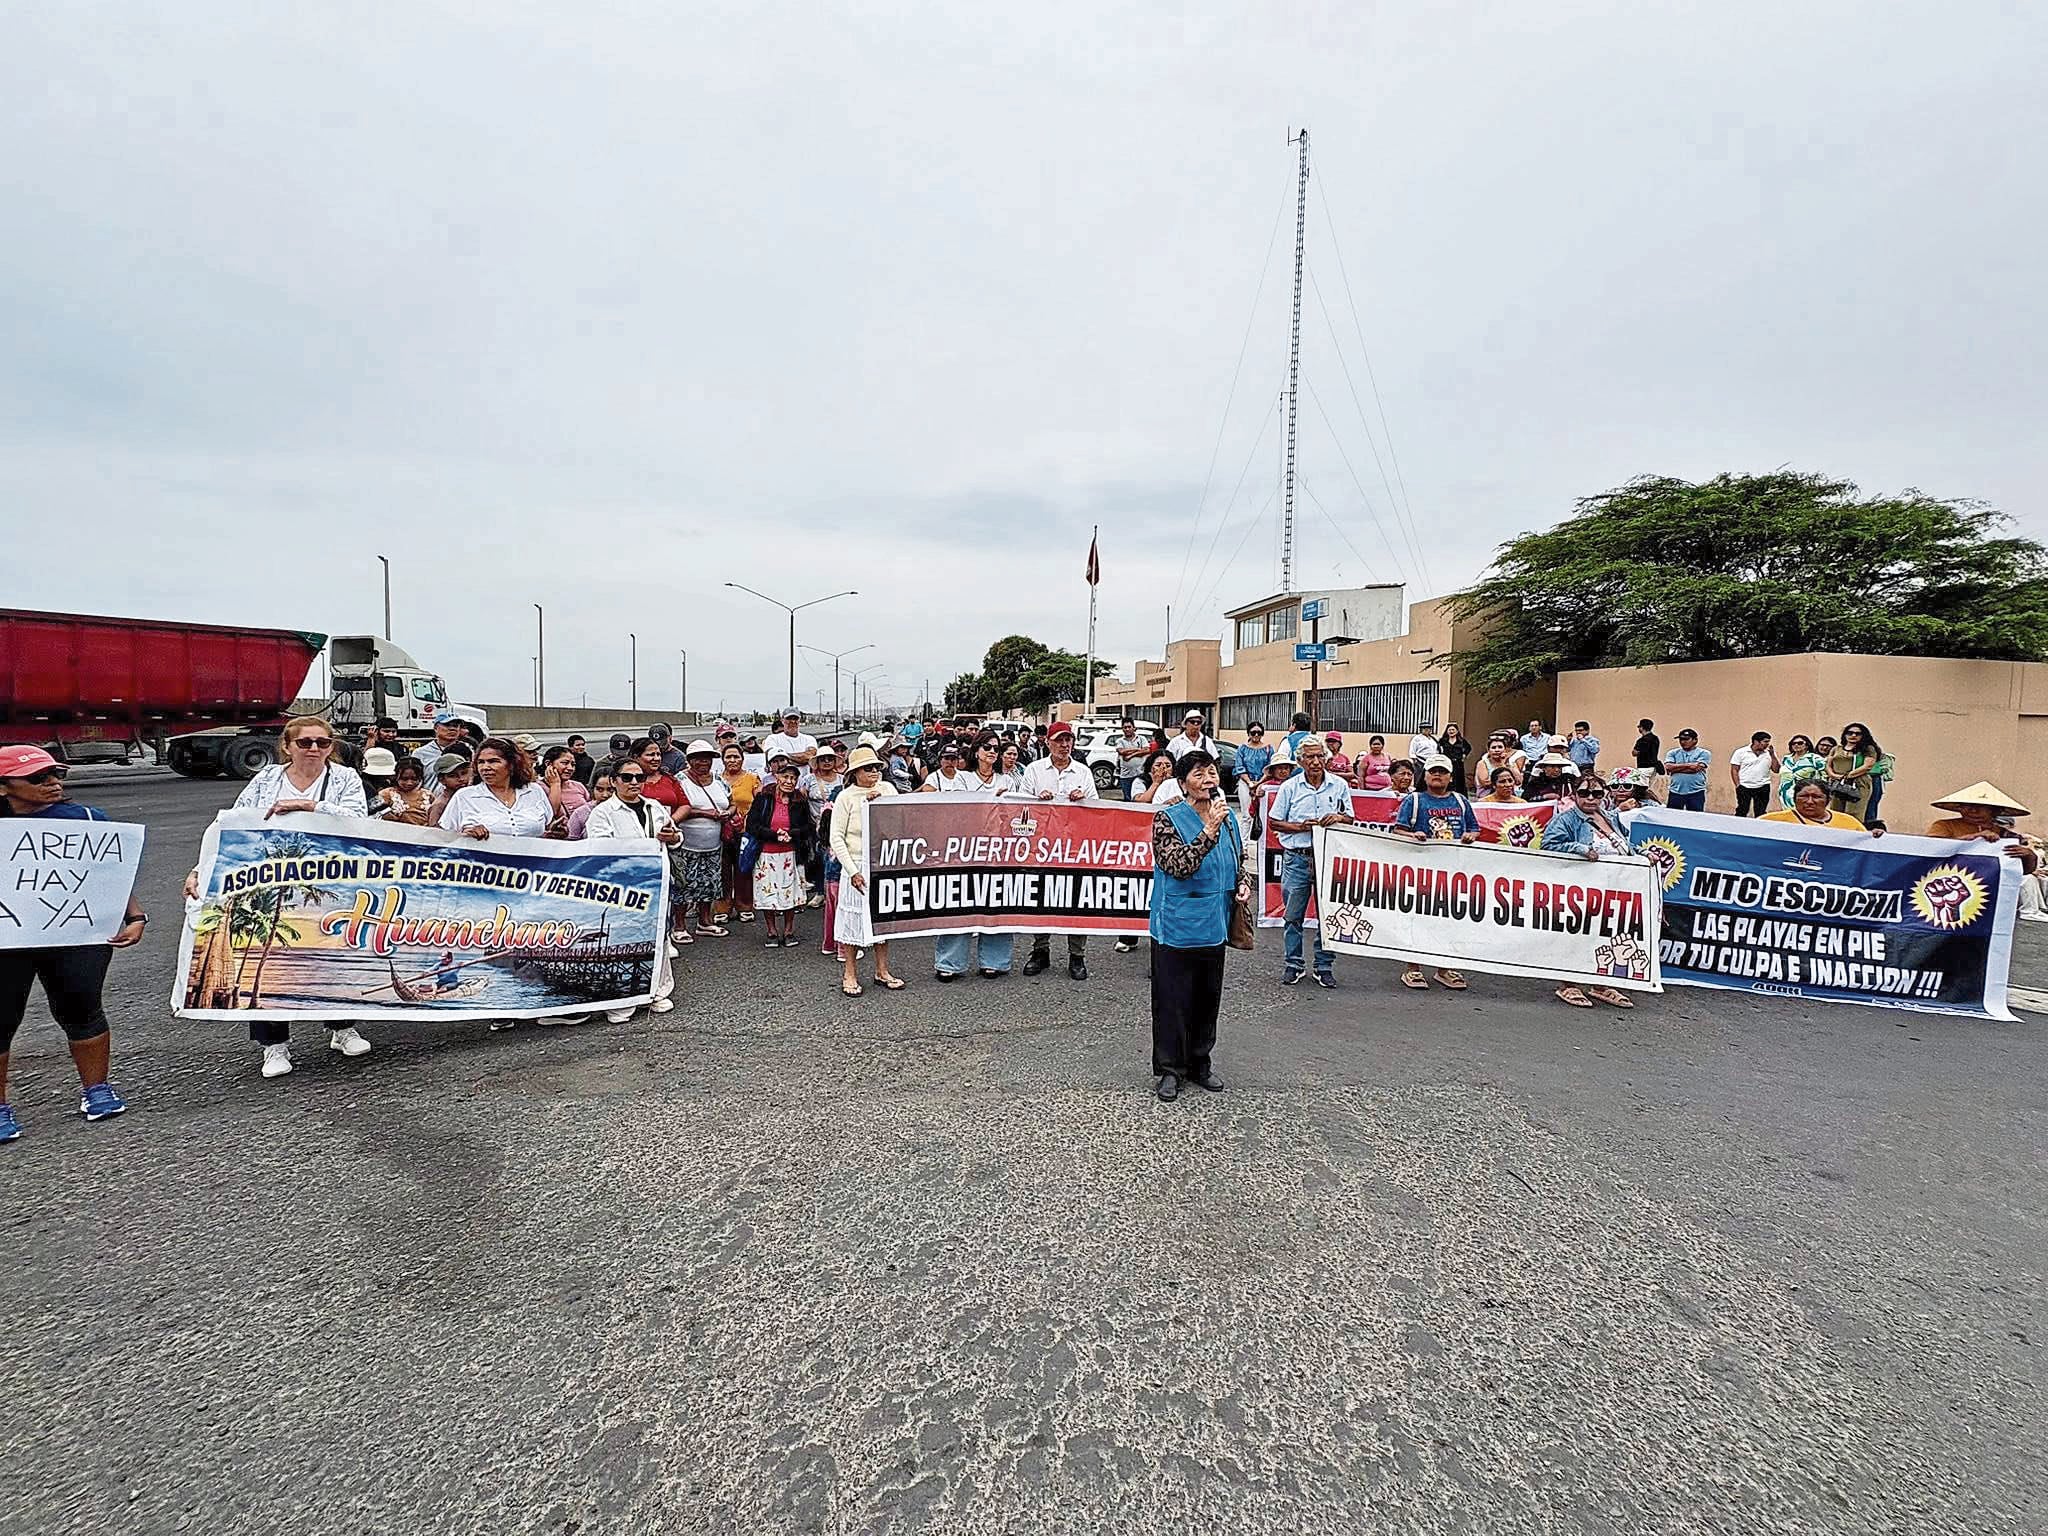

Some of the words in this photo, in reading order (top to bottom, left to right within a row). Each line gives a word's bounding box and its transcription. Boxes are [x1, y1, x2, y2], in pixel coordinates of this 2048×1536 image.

[10, 831, 122, 862] ARENA
[879, 838, 928, 867] MTC
[944, 836, 1031, 863] PUERTO
[16, 868, 89, 893] HAY
[222, 855, 358, 895] ASOCIACIÓN
[366, 859, 395, 879] DE
[402, 859, 529, 890] DESARROLLO
[535, 874, 547, 892] Y
[547, 877, 620, 905] DEFENSA
[624, 891, 650, 911] DE
[878, 873, 1040, 914] DEVUELVEME
[1044, 874, 1072, 908] MI
[1329, 856, 1487, 924] HUANCHACO
[1493, 876, 1525, 928] SE
[1532, 881, 1645, 942] RESPETA
[1693, 869, 1760, 905] MTC
[1766, 878, 1902, 920] ESCUCHA
[38, 897, 94, 930] YA
[320, 885, 583, 956] Huanchaco
[1691, 911, 1731, 942] LAS
[1733, 917, 1813, 953] PLAYAS
[1815, 926, 1843, 957] EN
[1848, 930, 1886, 961] PIE
[1659, 939, 1687, 966] OR
[1687, 943, 1717, 970] TU
[1717, 947, 1784, 981] CULPA
[1787, 955, 1801, 983] E
[1809, 957, 1919, 995] INACCION
